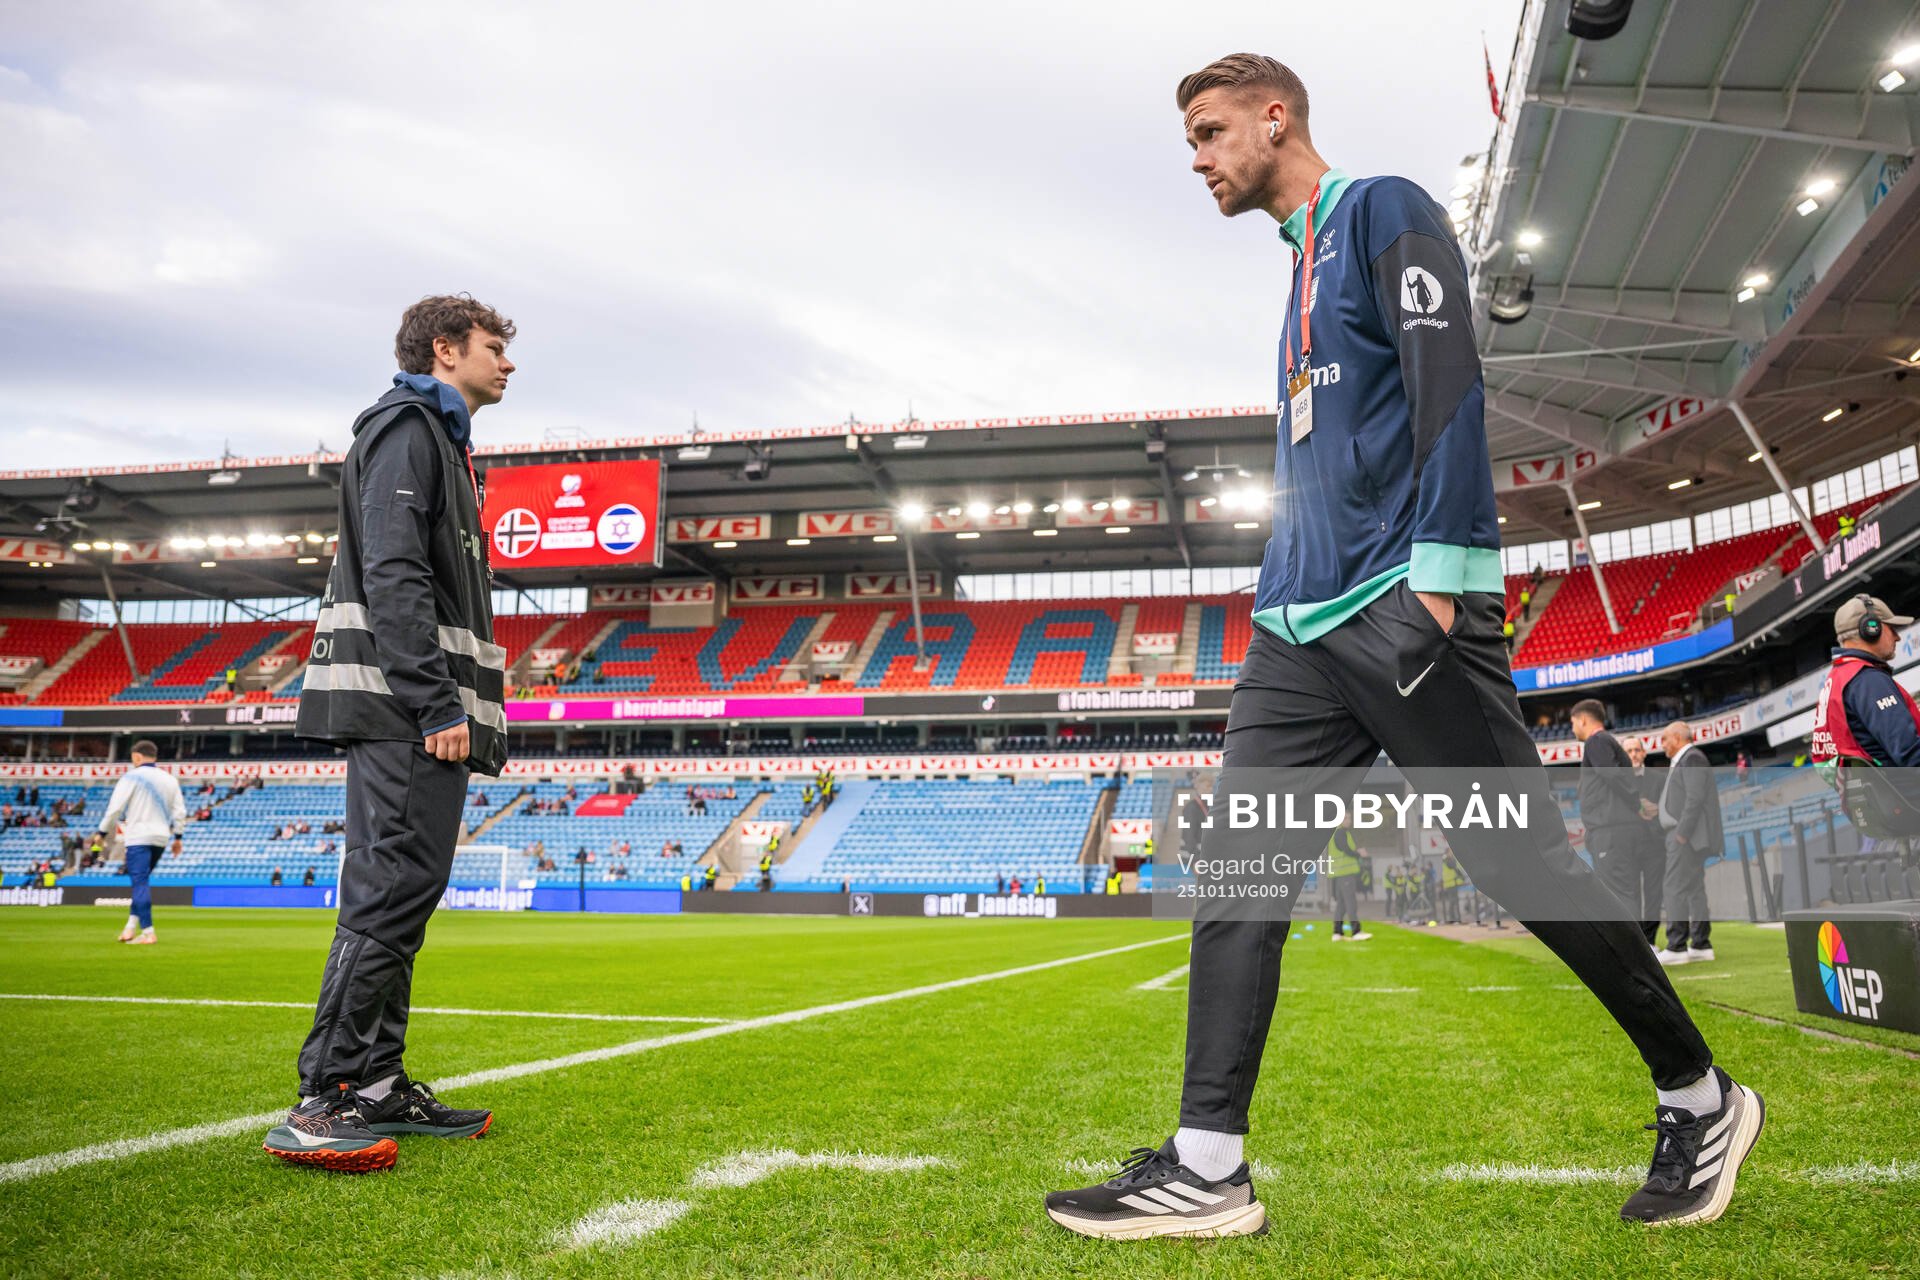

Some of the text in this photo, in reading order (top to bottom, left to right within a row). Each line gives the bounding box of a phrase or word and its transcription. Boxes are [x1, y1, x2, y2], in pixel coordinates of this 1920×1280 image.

[1402, 316, 1449, 331] Gjensidige
[1310, 362, 1341, 388] ma
[1636, 397, 1704, 438] VG
[677, 515, 761, 541] VG
[807, 512, 896, 536] VG
[0, 538, 66, 559] VG
[593, 587, 649, 603] VG
[653, 586, 713, 603] VG
[735, 578, 820, 600] VG
[851, 575, 936, 597] VG
[1536, 648, 1655, 690] @fotballandslaget
[612, 699, 726, 719] @herrelandslaget
[1057, 689, 1196, 712] @fotballandslaget
[1876, 694, 1898, 711] HH
[1539, 745, 1581, 762] VG
[1715, 714, 1742, 738] VG
[504, 761, 545, 774] VG
[554, 761, 595, 773] VG
[604, 761, 645, 773] VG
[654, 760, 697, 773] VG
[706, 760, 749, 772] VG
[759, 759, 802, 772] VG
[812, 759, 856, 771] VG
[866, 758, 910, 770] VG
[921, 757, 966, 769] VG
[976, 757, 1022, 769] VG
[1033, 756, 1079, 768] VG
[1089, 755, 1136, 767] VG
[1147, 754, 1194, 766] VG
[0, 886, 64, 908] ndslaget
[923, 892, 1057, 919] @nff_landslag
[1836, 965, 1884, 1021] NEP
